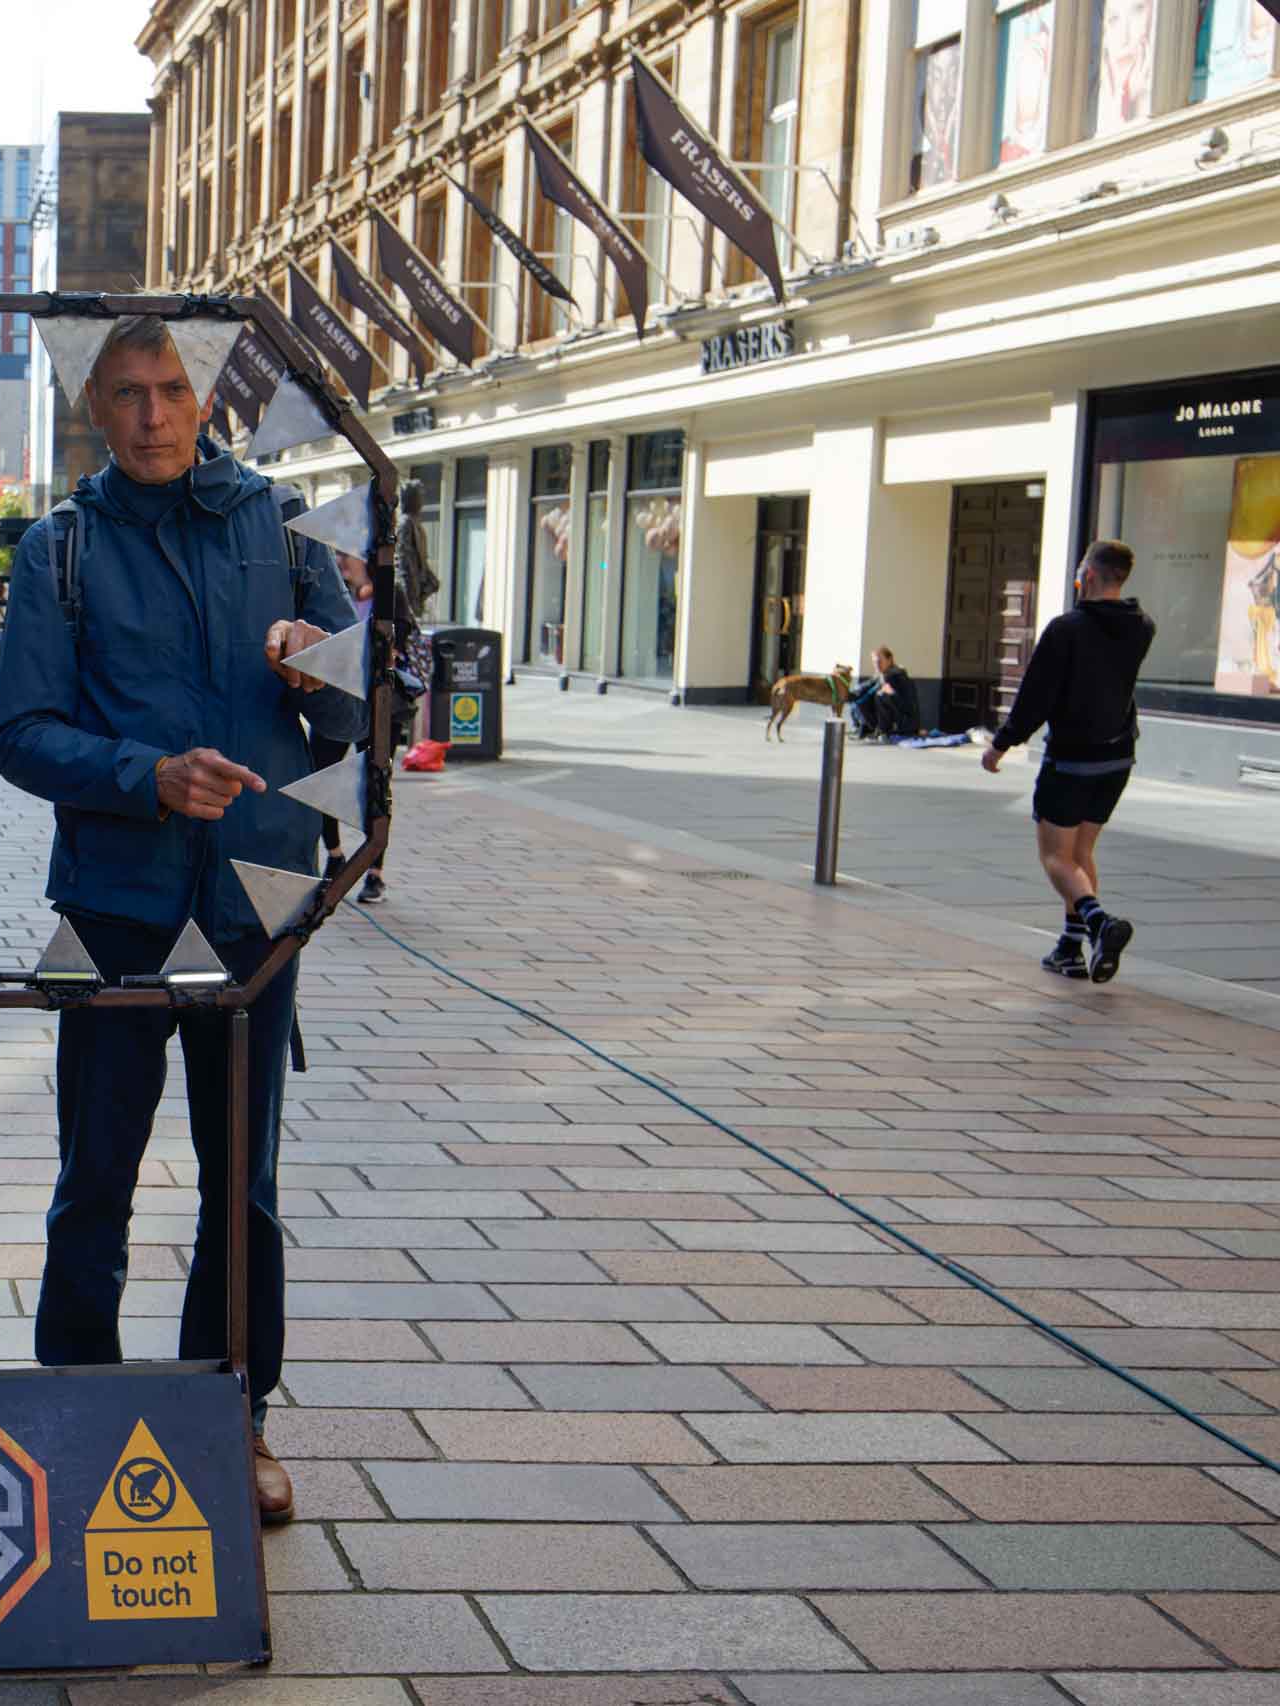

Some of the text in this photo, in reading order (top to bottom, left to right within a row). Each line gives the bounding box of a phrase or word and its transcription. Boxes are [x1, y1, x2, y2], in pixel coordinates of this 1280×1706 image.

[670, 130, 756, 222] FRASERS
[405, 257, 462, 325] FRASERS
[308, 304, 361, 362] FRASERS
[699, 319, 794, 376] FRASERS
[1175, 399, 1263, 421] JO MALONE
[103, 1550, 198, 1576] Do not
[111, 1581, 192, 1608] touch
